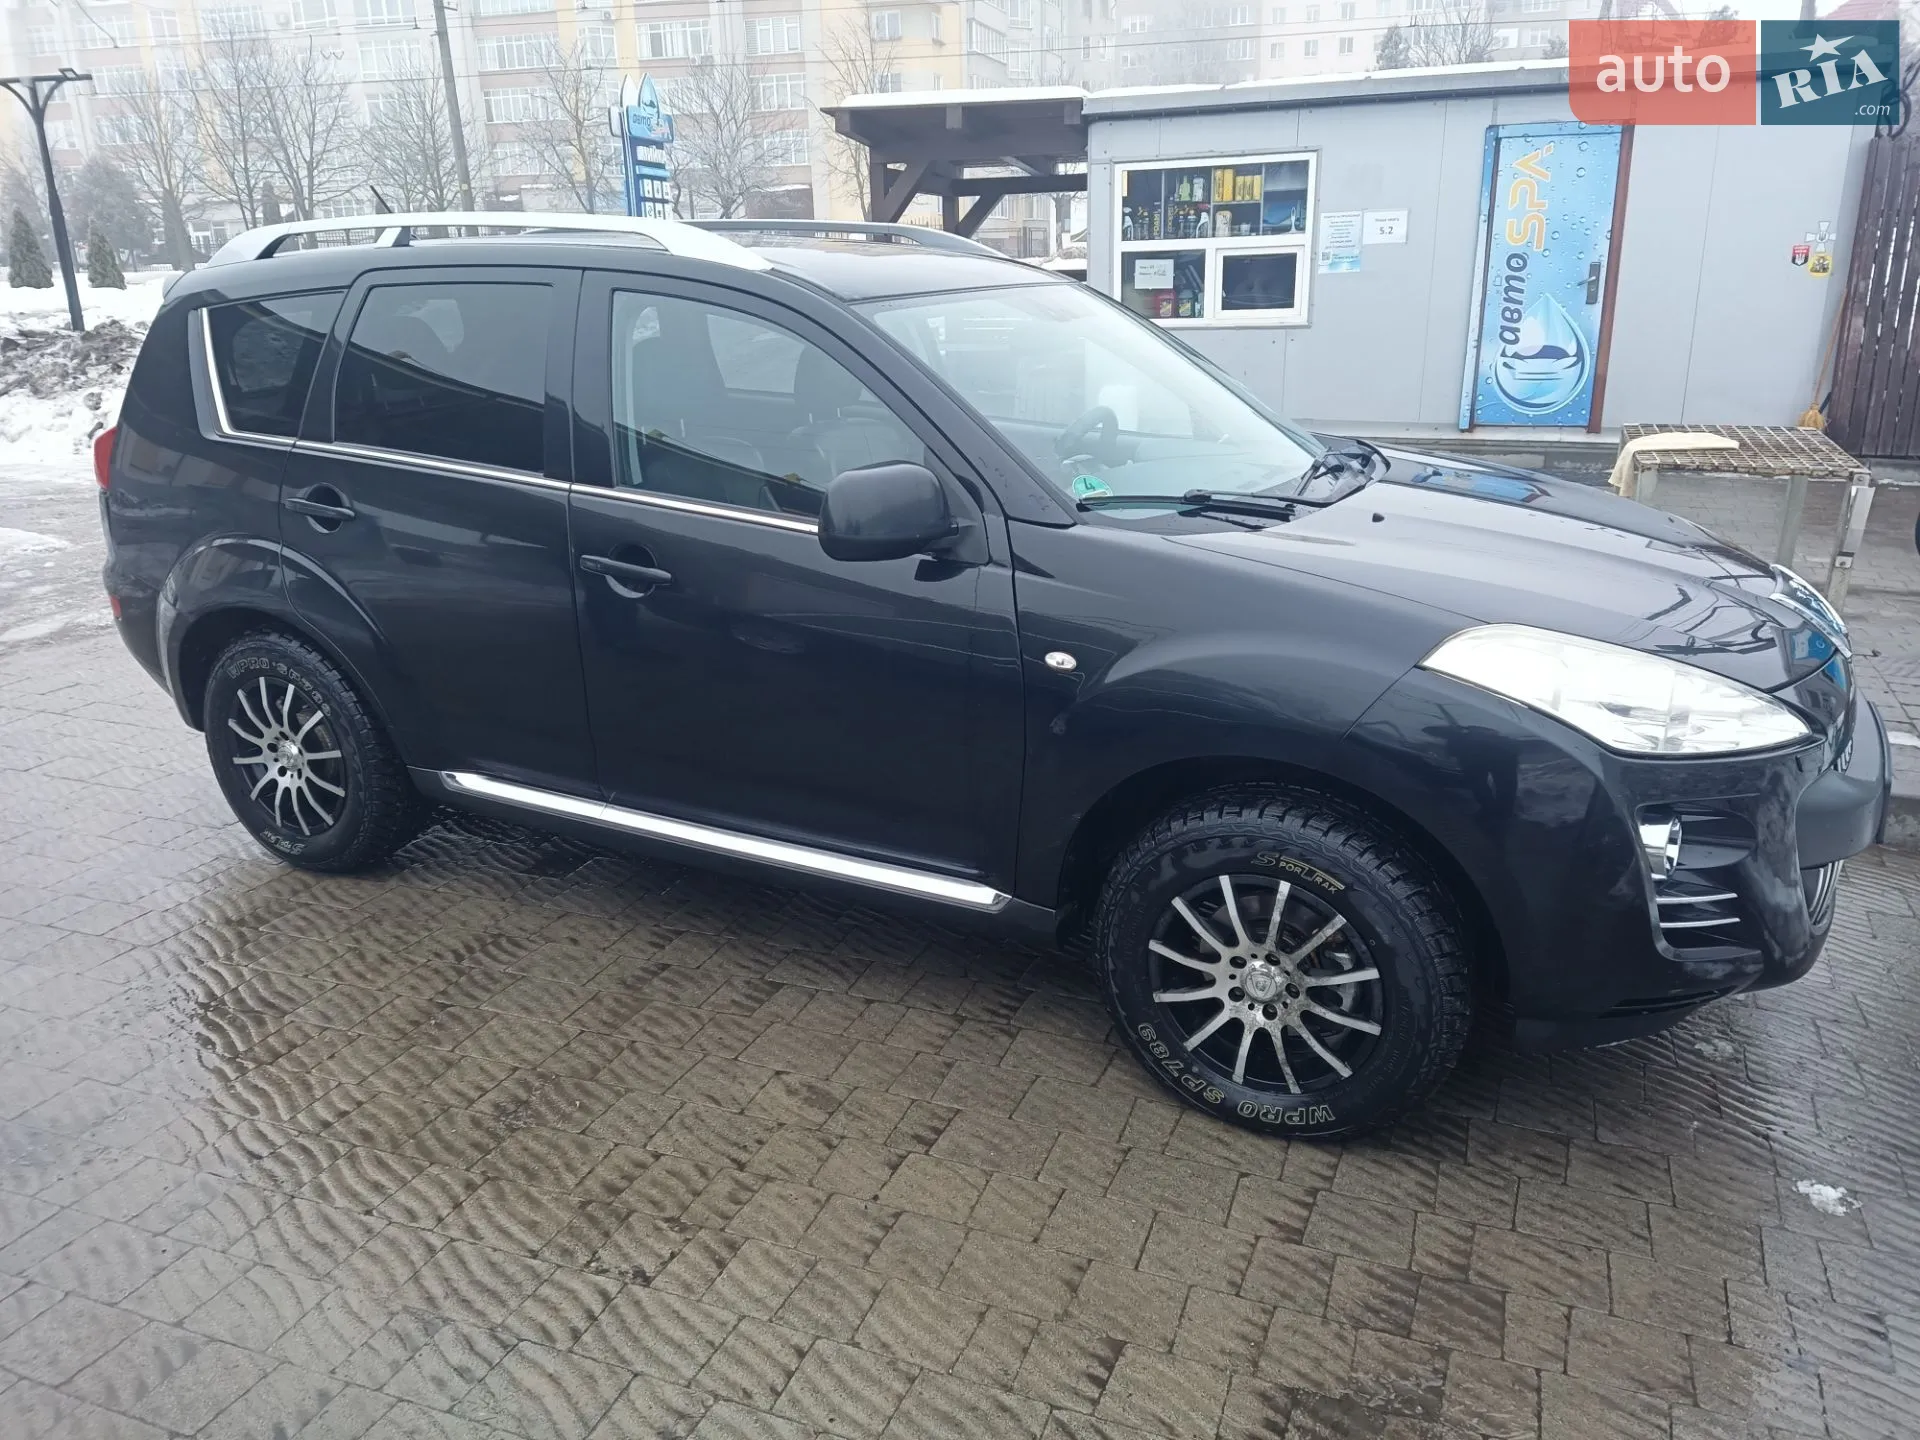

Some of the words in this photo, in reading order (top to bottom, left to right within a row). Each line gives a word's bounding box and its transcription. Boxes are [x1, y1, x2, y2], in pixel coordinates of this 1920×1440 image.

[1506, 143, 1555, 252] SPA
[1498, 252, 1529, 345] авто
[1137, 1022, 1226, 1105] SP789
[1237, 1100, 1336, 1126] WPRO
